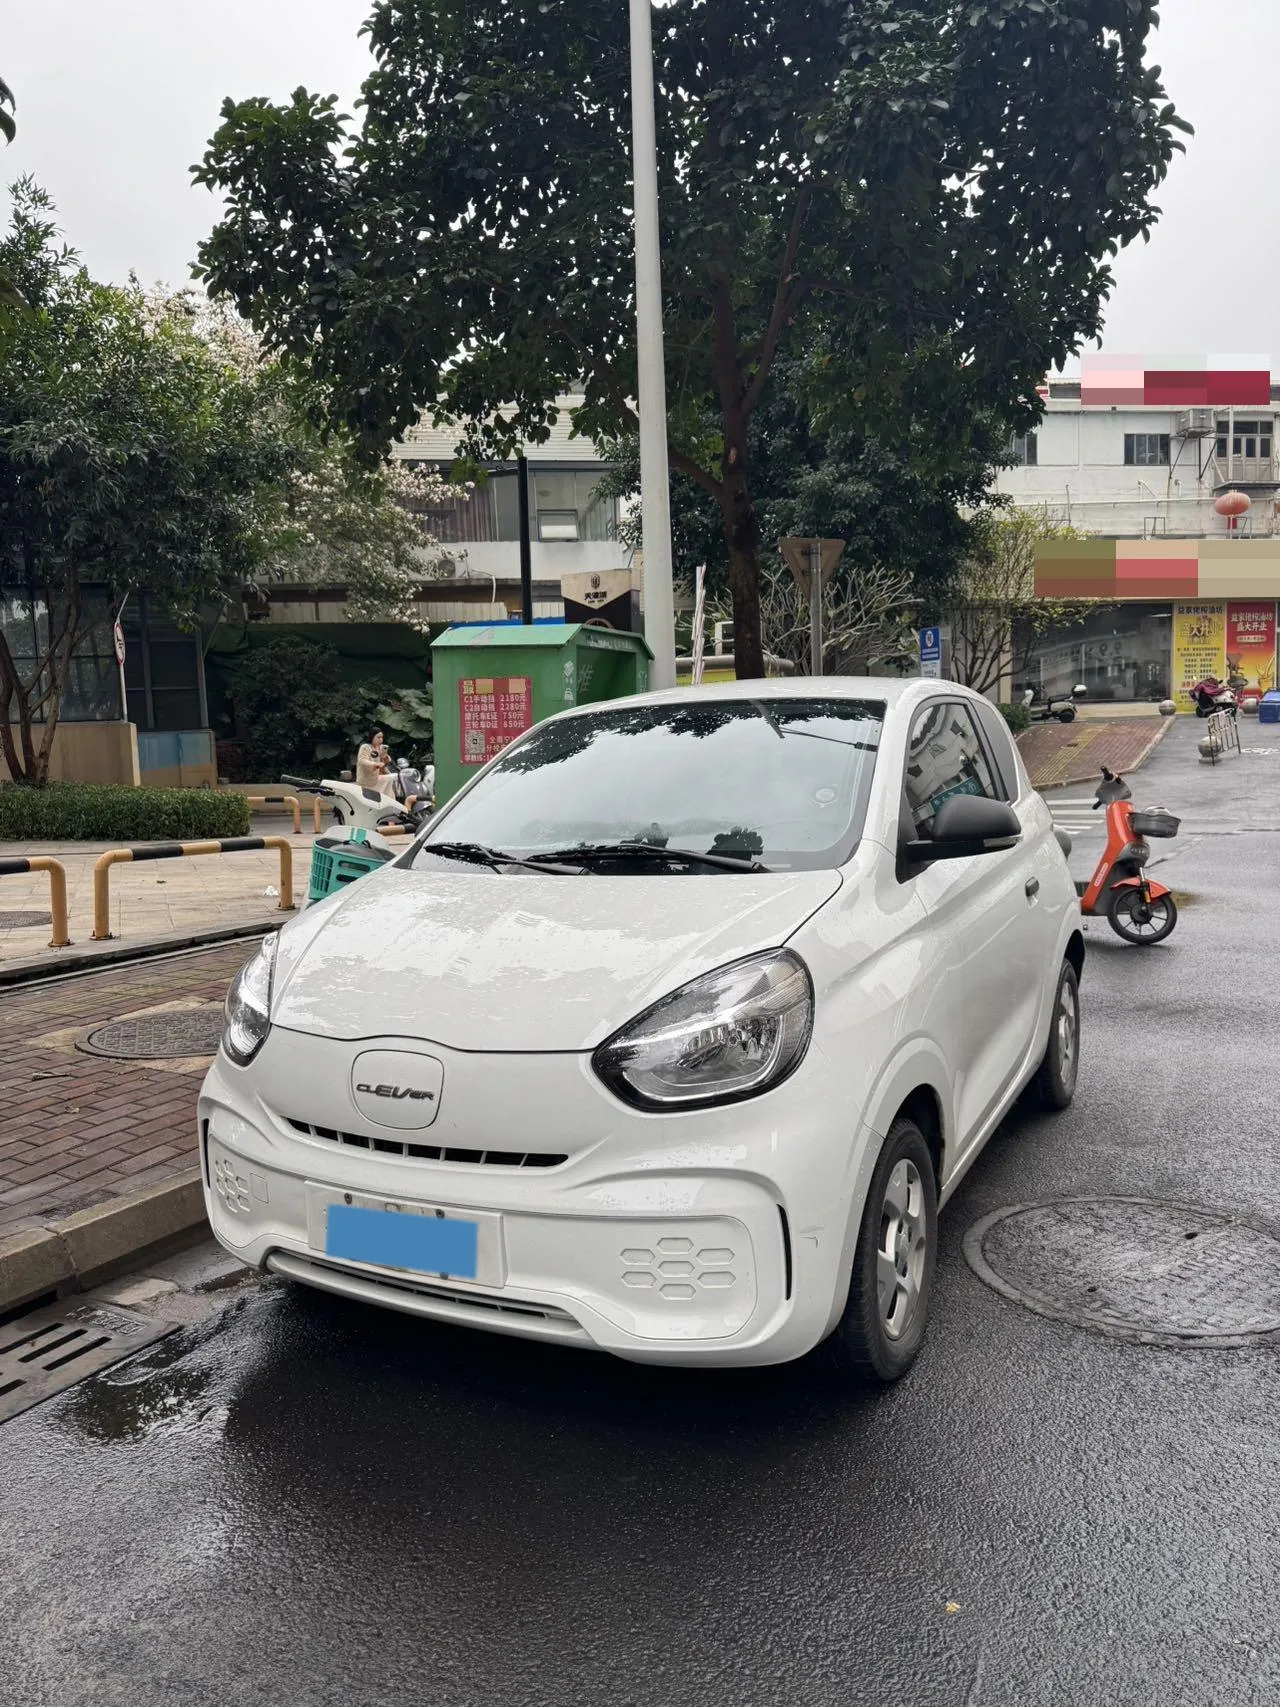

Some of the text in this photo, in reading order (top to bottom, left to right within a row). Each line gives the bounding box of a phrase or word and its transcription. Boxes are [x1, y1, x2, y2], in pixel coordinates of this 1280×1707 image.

[1236, 621, 1268, 632] 盛大开业
[464, 702, 527, 712] C2自动挡 2280元
[464, 711, 525, 721] 摩托车E证 750元
[465, 720, 525, 730] 三轮车D证 850元
[356, 1083, 434, 1101] CLEVER
